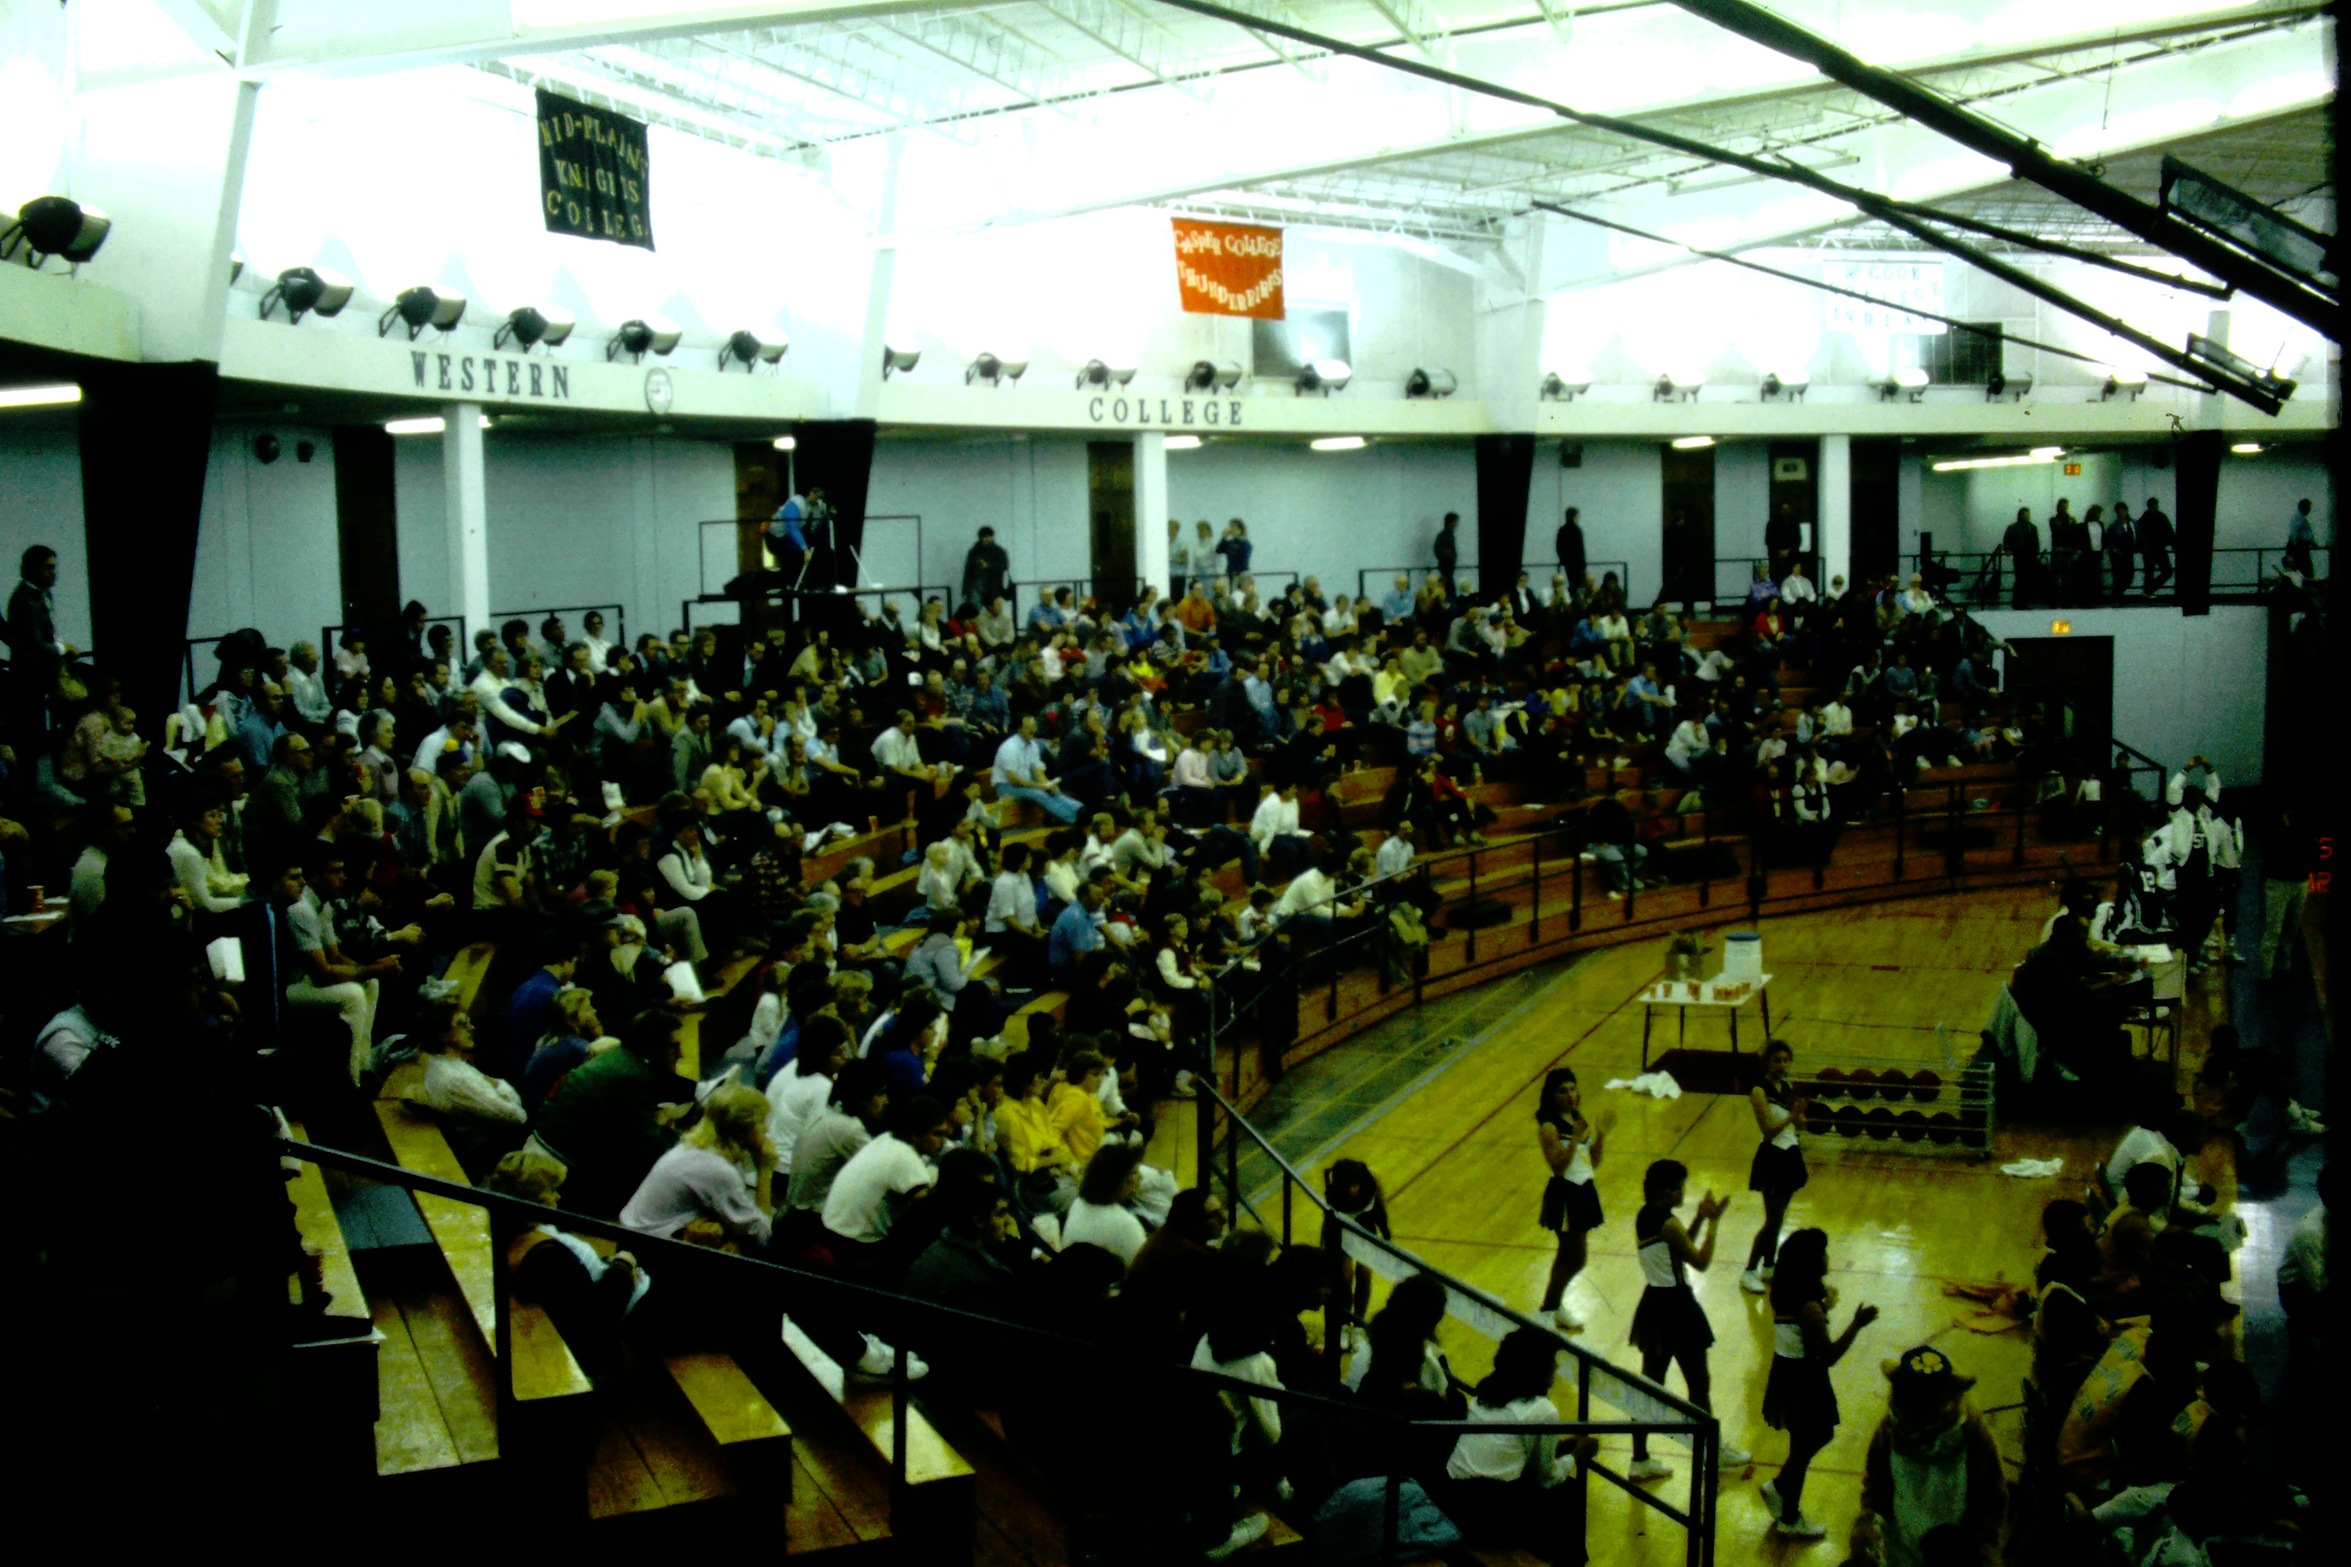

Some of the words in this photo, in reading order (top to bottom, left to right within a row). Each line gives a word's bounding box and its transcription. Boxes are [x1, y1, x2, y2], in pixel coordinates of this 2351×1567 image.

[546, 189, 649, 238] COLLEG
[1174, 229, 1222, 256] CASPER
[1225, 234, 1282, 258] COLLEGE
[1177, 259, 1282, 311] THUNDERBIRDS
[410, 350, 570, 398] WESTERN
[1089, 397, 1242, 425] COLLEGE
